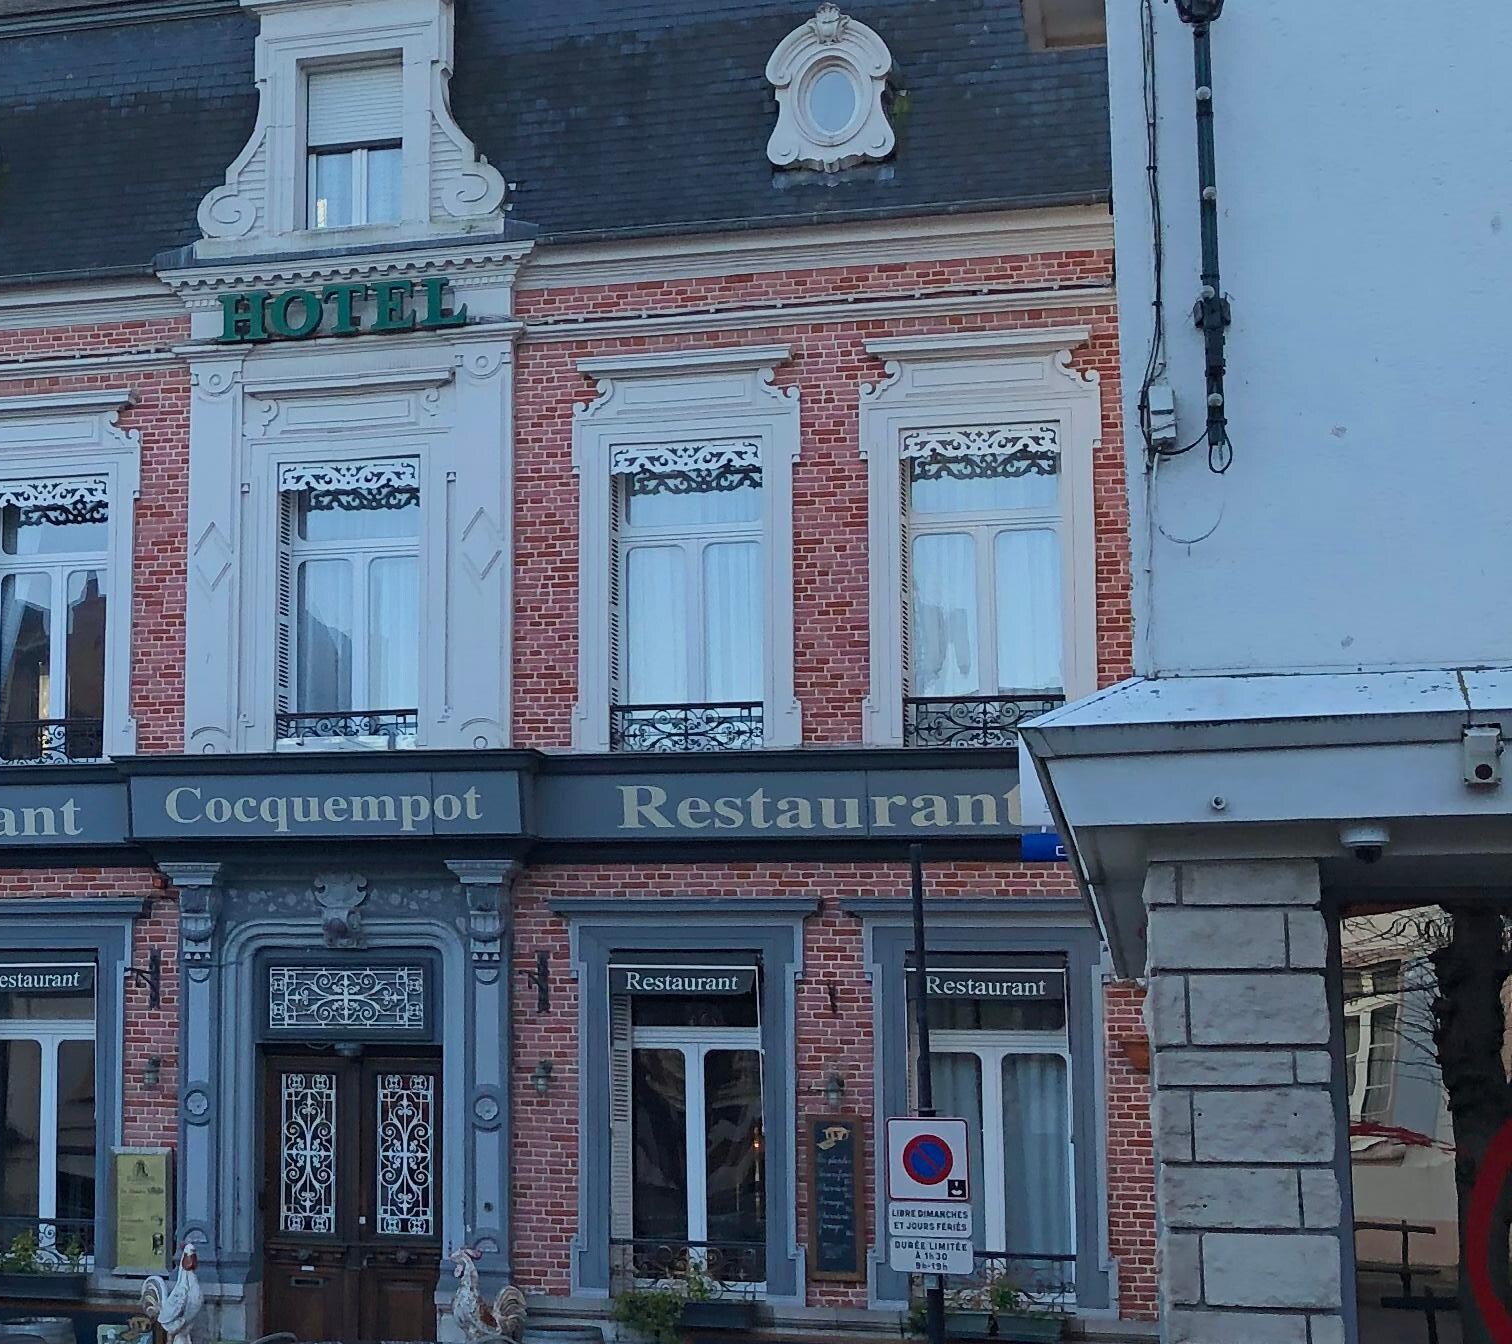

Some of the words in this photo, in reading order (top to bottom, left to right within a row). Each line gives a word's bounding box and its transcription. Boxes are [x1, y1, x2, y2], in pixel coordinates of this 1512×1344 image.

[217, 277, 468, 342] HOTEL
[165, 784, 483, 832] Cocquempot
[616, 784, 1022, 829] Restaurant
[625, 971, 739, 992] Restaurant
[925, 975, 1047, 997] Restaurant
[918, 1210, 968, 1219] DIMANCHES
[894, 1222, 903, 1230] ET
[906, 1222, 935, 1230] JOURS
